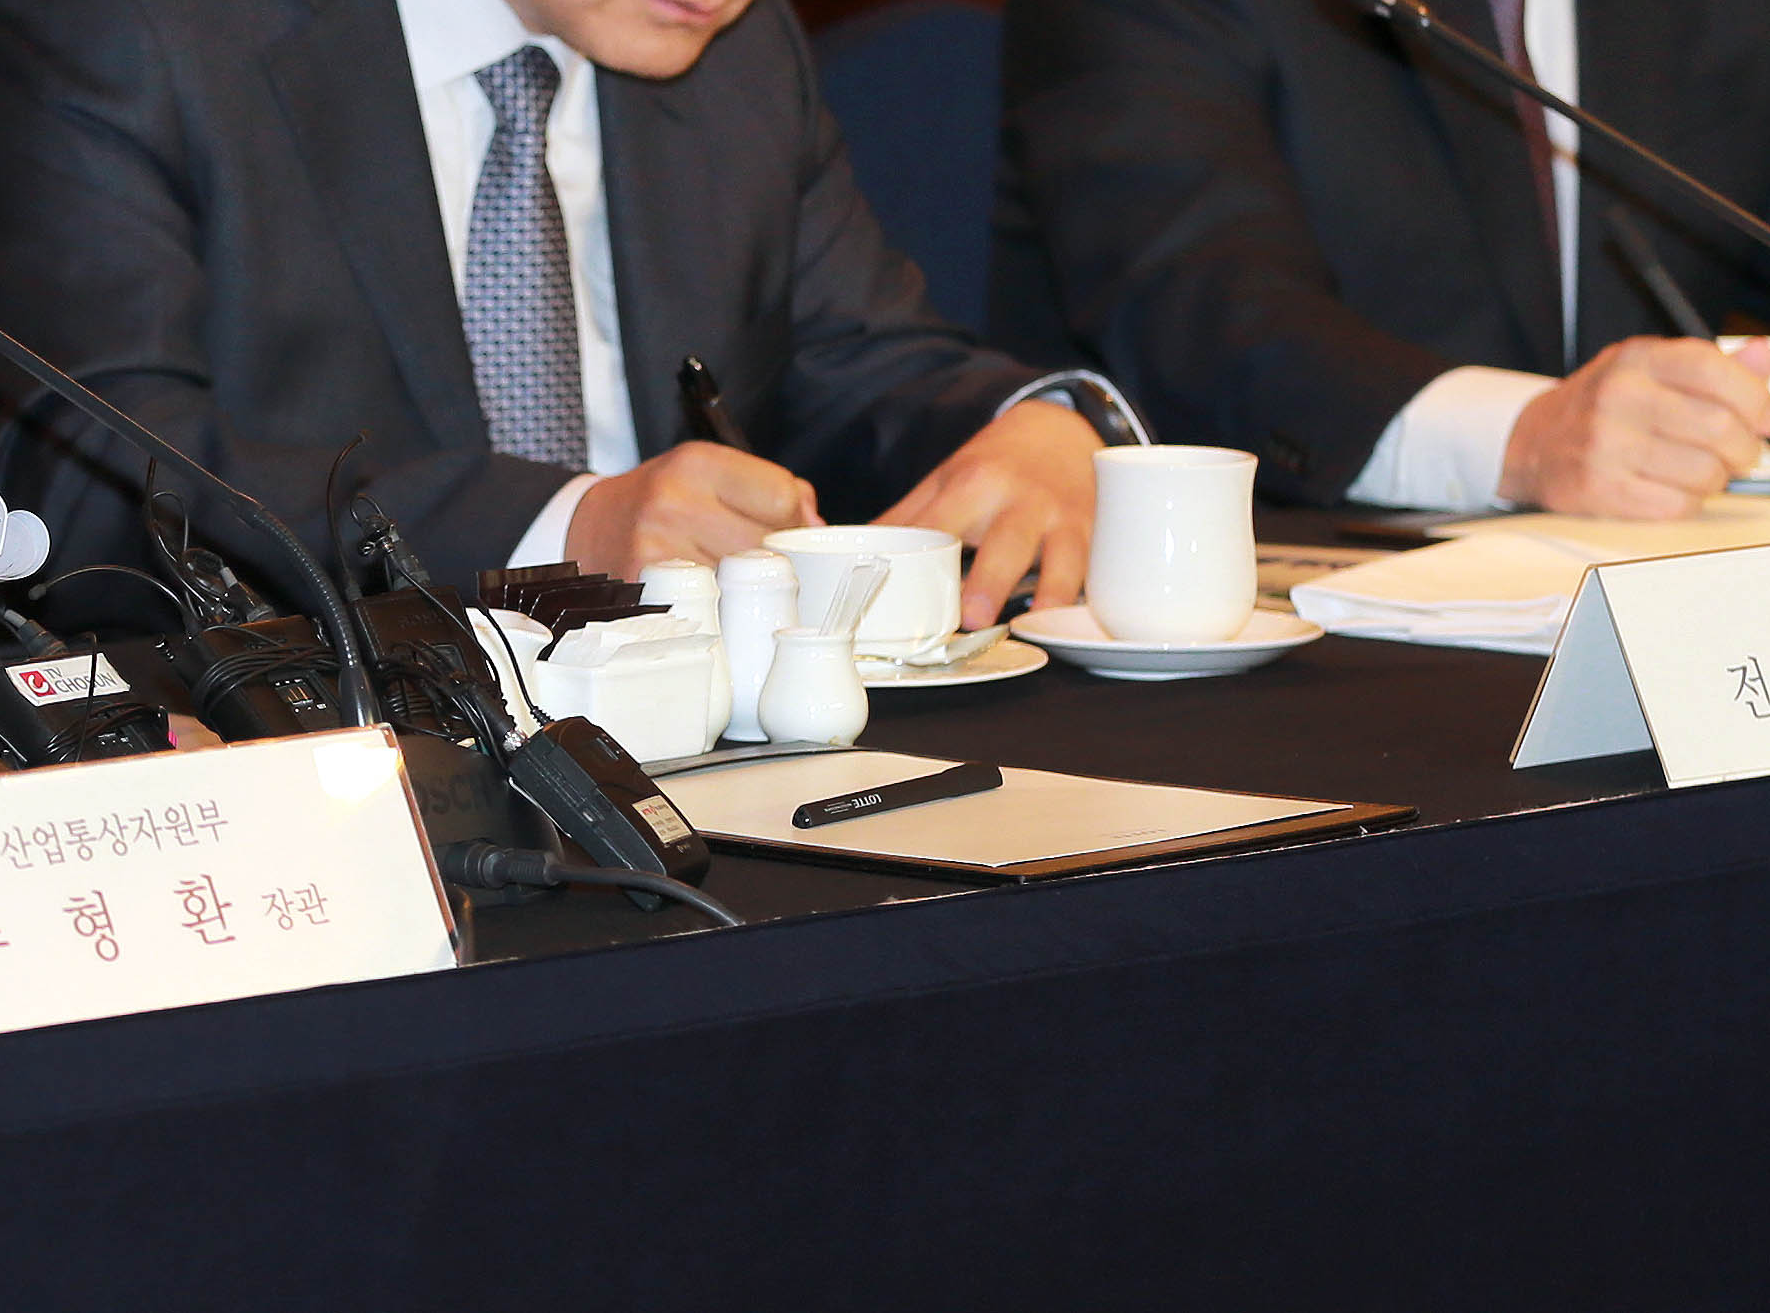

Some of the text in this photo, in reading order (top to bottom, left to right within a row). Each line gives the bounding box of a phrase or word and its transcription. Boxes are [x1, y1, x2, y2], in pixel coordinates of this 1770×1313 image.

[44, 667, 63, 680] TV
[1726, 655, 1770, 719] 전
[850, 793, 882, 809] LOTTE
[0, 798, 229, 870] 산업통상자원부
[62, 889, 120, 962] 형
[173, 873, 237, 945] 환
[260, 882, 331, 931] 장관
